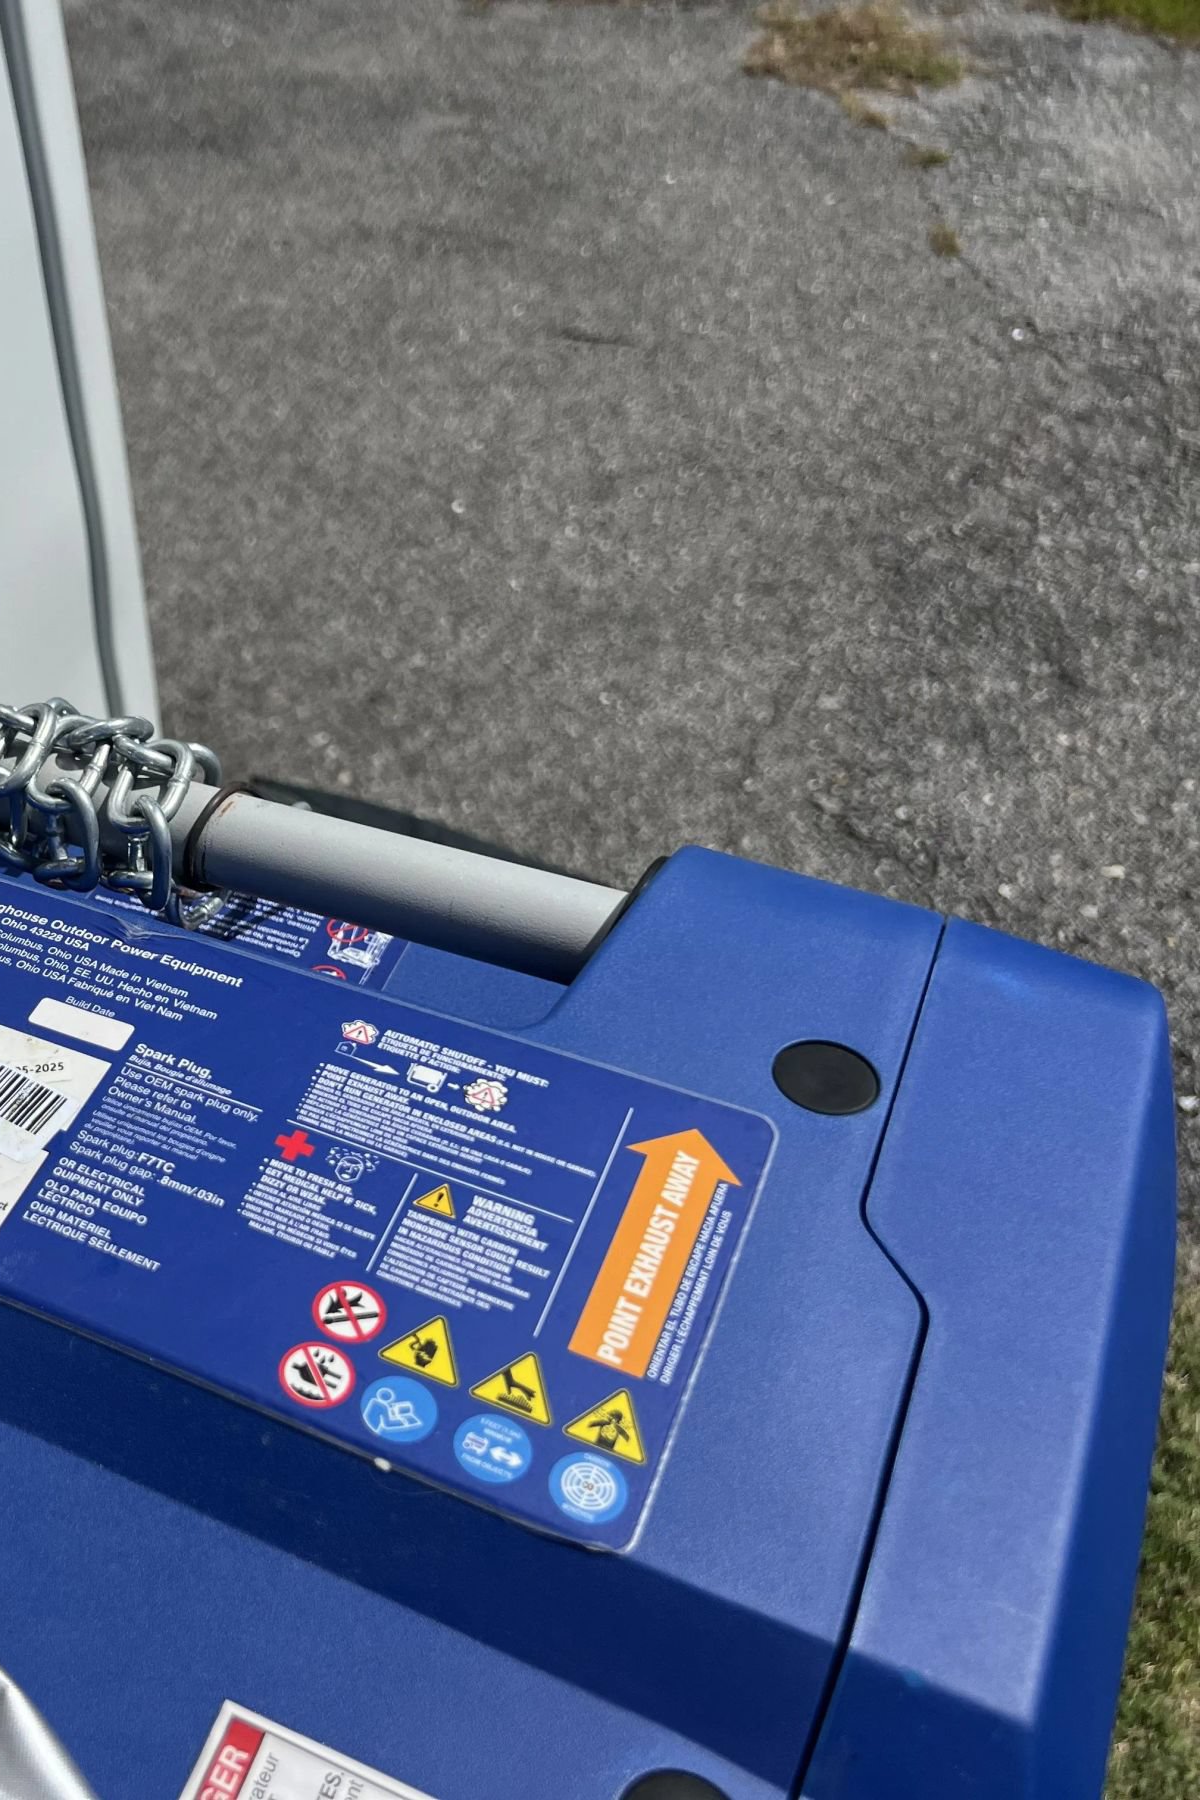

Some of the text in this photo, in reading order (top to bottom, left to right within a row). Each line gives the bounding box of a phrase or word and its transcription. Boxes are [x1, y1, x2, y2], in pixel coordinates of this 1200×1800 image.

[0, 916, 29, 932] Ohio
[28, 925, 64, 943] 43228
[63, 935, 90, 952] USA
[49, 918, 110, 946] Outdoor
[109, 938, 160, 961] Power
[158, 953, 244, 988] Equipment
[46, 945, 73, 961] Ohio
[72, 953, 99, 970] USA
[97, 961, 130, 979] Made
[129, 972, 143, 984] in
[144, 976, 189, 999] Vietnam
[62, 994, 116, 1020] Build Date
[133, 1042, 213, 1081] Spark Plug,
[382, 1028, 550, 1087] AUTOMATIC SHUTOFF YOU MUST:
[107, 1084, 197, 1125] Owner's Manual.
[112, 1074, 193, 1111] Please refer to
[119, 1065, 144, 1081] Use
[143, 1073, 175, 1092] OEM
[172, 1085, 206, 1103] spark
[203, 1097, 232, 1114] plug
[68, 1140, 104, 1161] Spark
[100, 1154, 129, 1172] plug
[127, 1164, 156, 1180] gap:
[75, 1162, 145, 1197] ELECTRICAL
[110, 1188, 144, 1207] ONLY
[54, 1209, 112, 1240] MATERIEL
[68, 1187, 102, 1208] PARA
[101, 1199, 148, 1225] EQUIPO
[466, 1205, 538, 1238] ADVERTENCIA
[471, 1194, 535, 1226] WARNING
[462, 1213, 548, 1251] AVERTISSEMENT
[87, 1235, 161, 1271] SEULEMENT
[596, 1150, 700, 1365] POINT EXHAUST AWAY
[645, 1182, 729, 1379] ORIENTAR EL TUBO DE ESCAPE HACIA AFUERA
